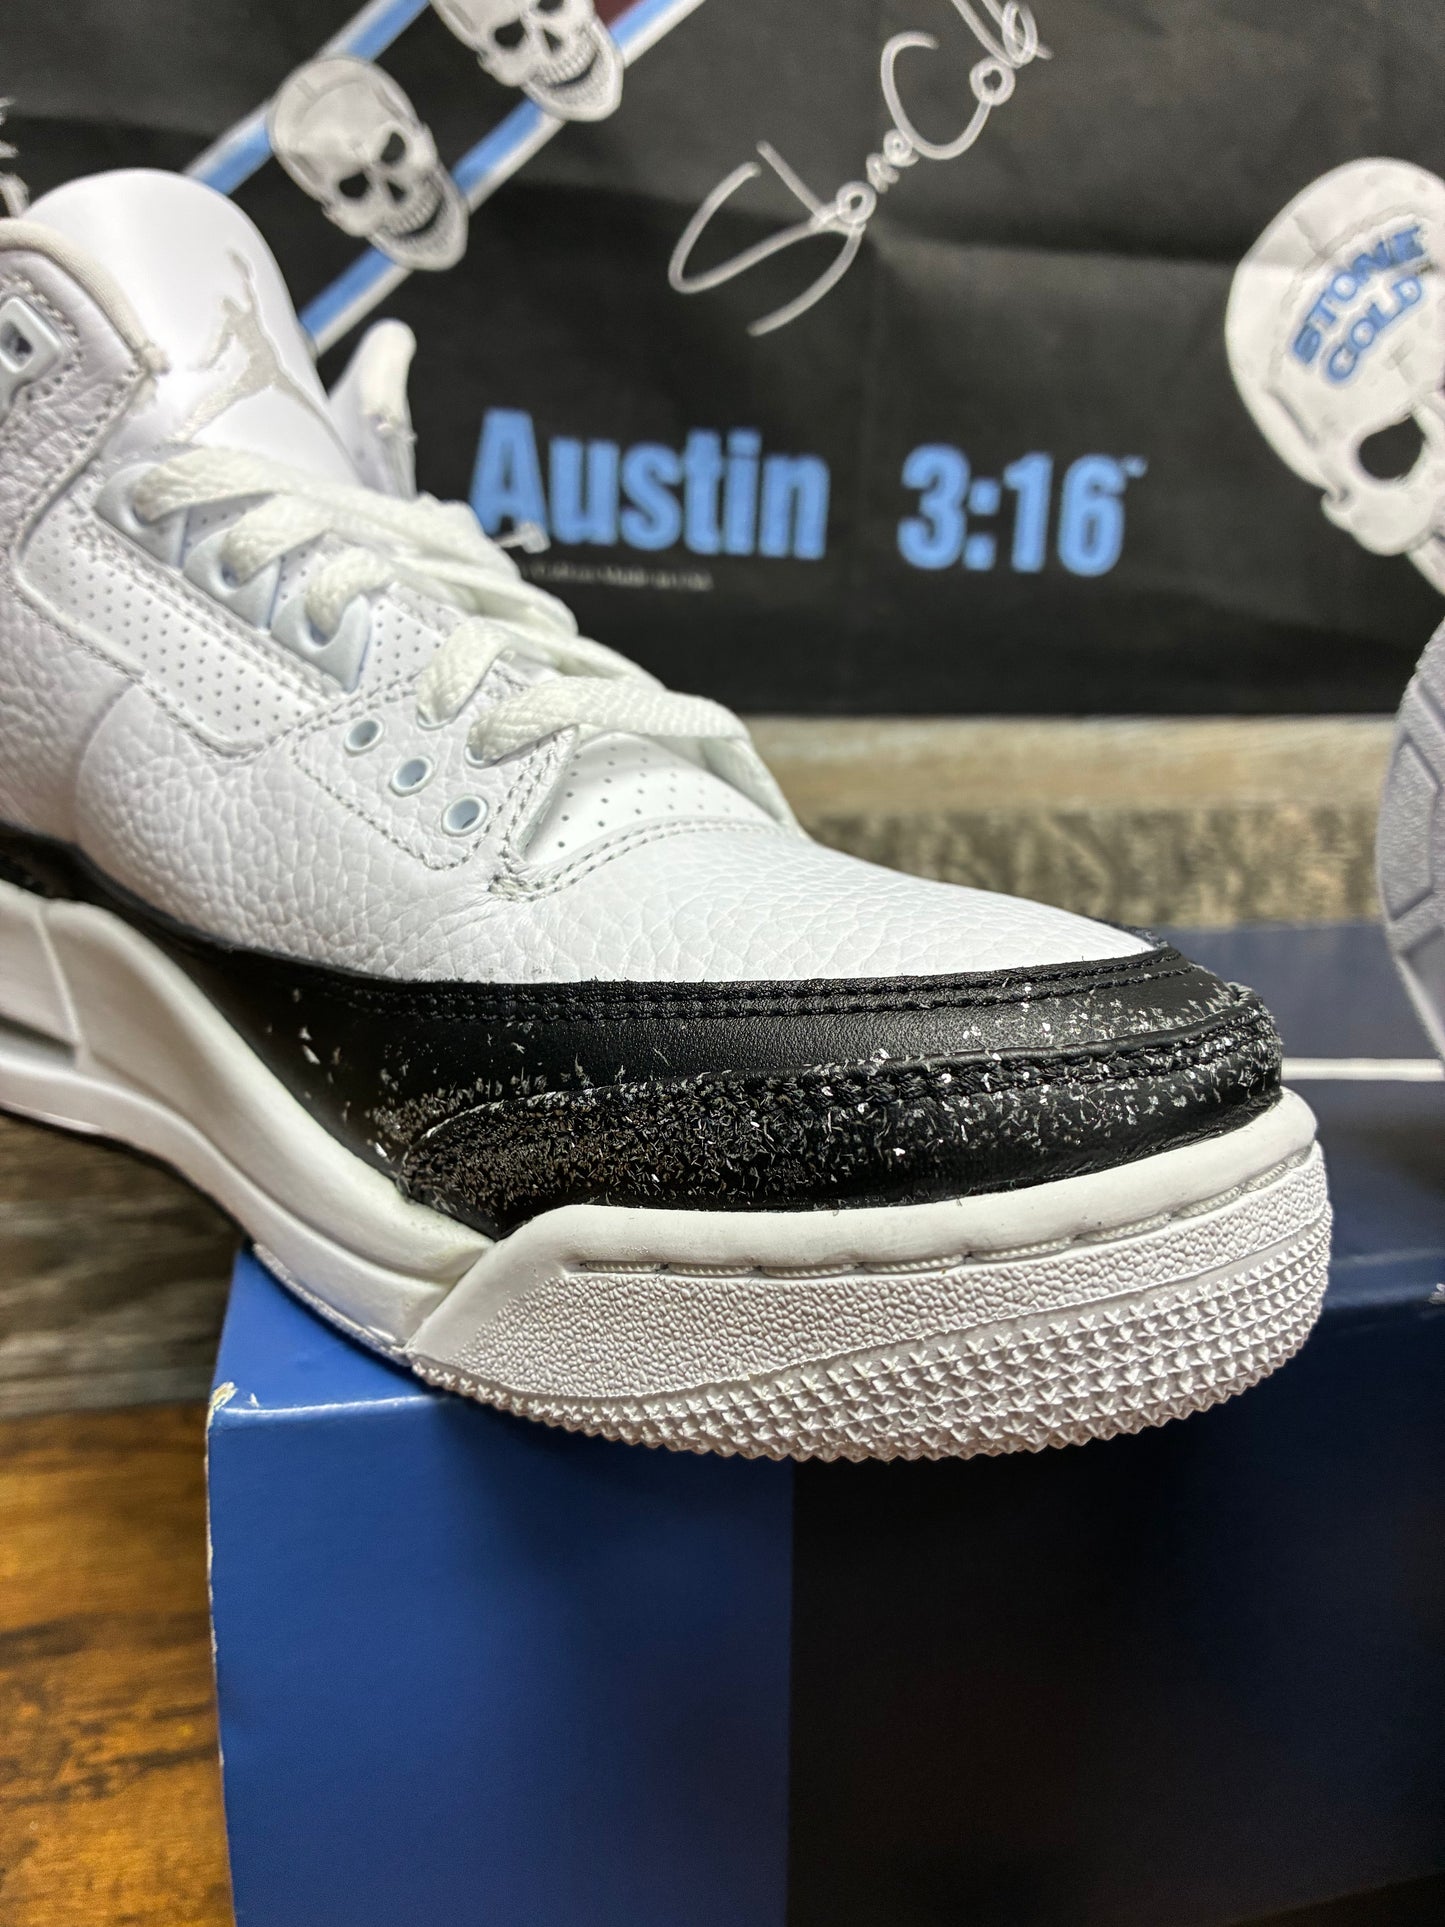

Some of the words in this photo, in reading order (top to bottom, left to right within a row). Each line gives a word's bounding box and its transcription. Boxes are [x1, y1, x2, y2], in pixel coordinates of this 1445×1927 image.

[1293, 225, 1425, 364] STONE
[1327, 276, 1422, 384] COLD
[468, 408, 831, 560] Austin
